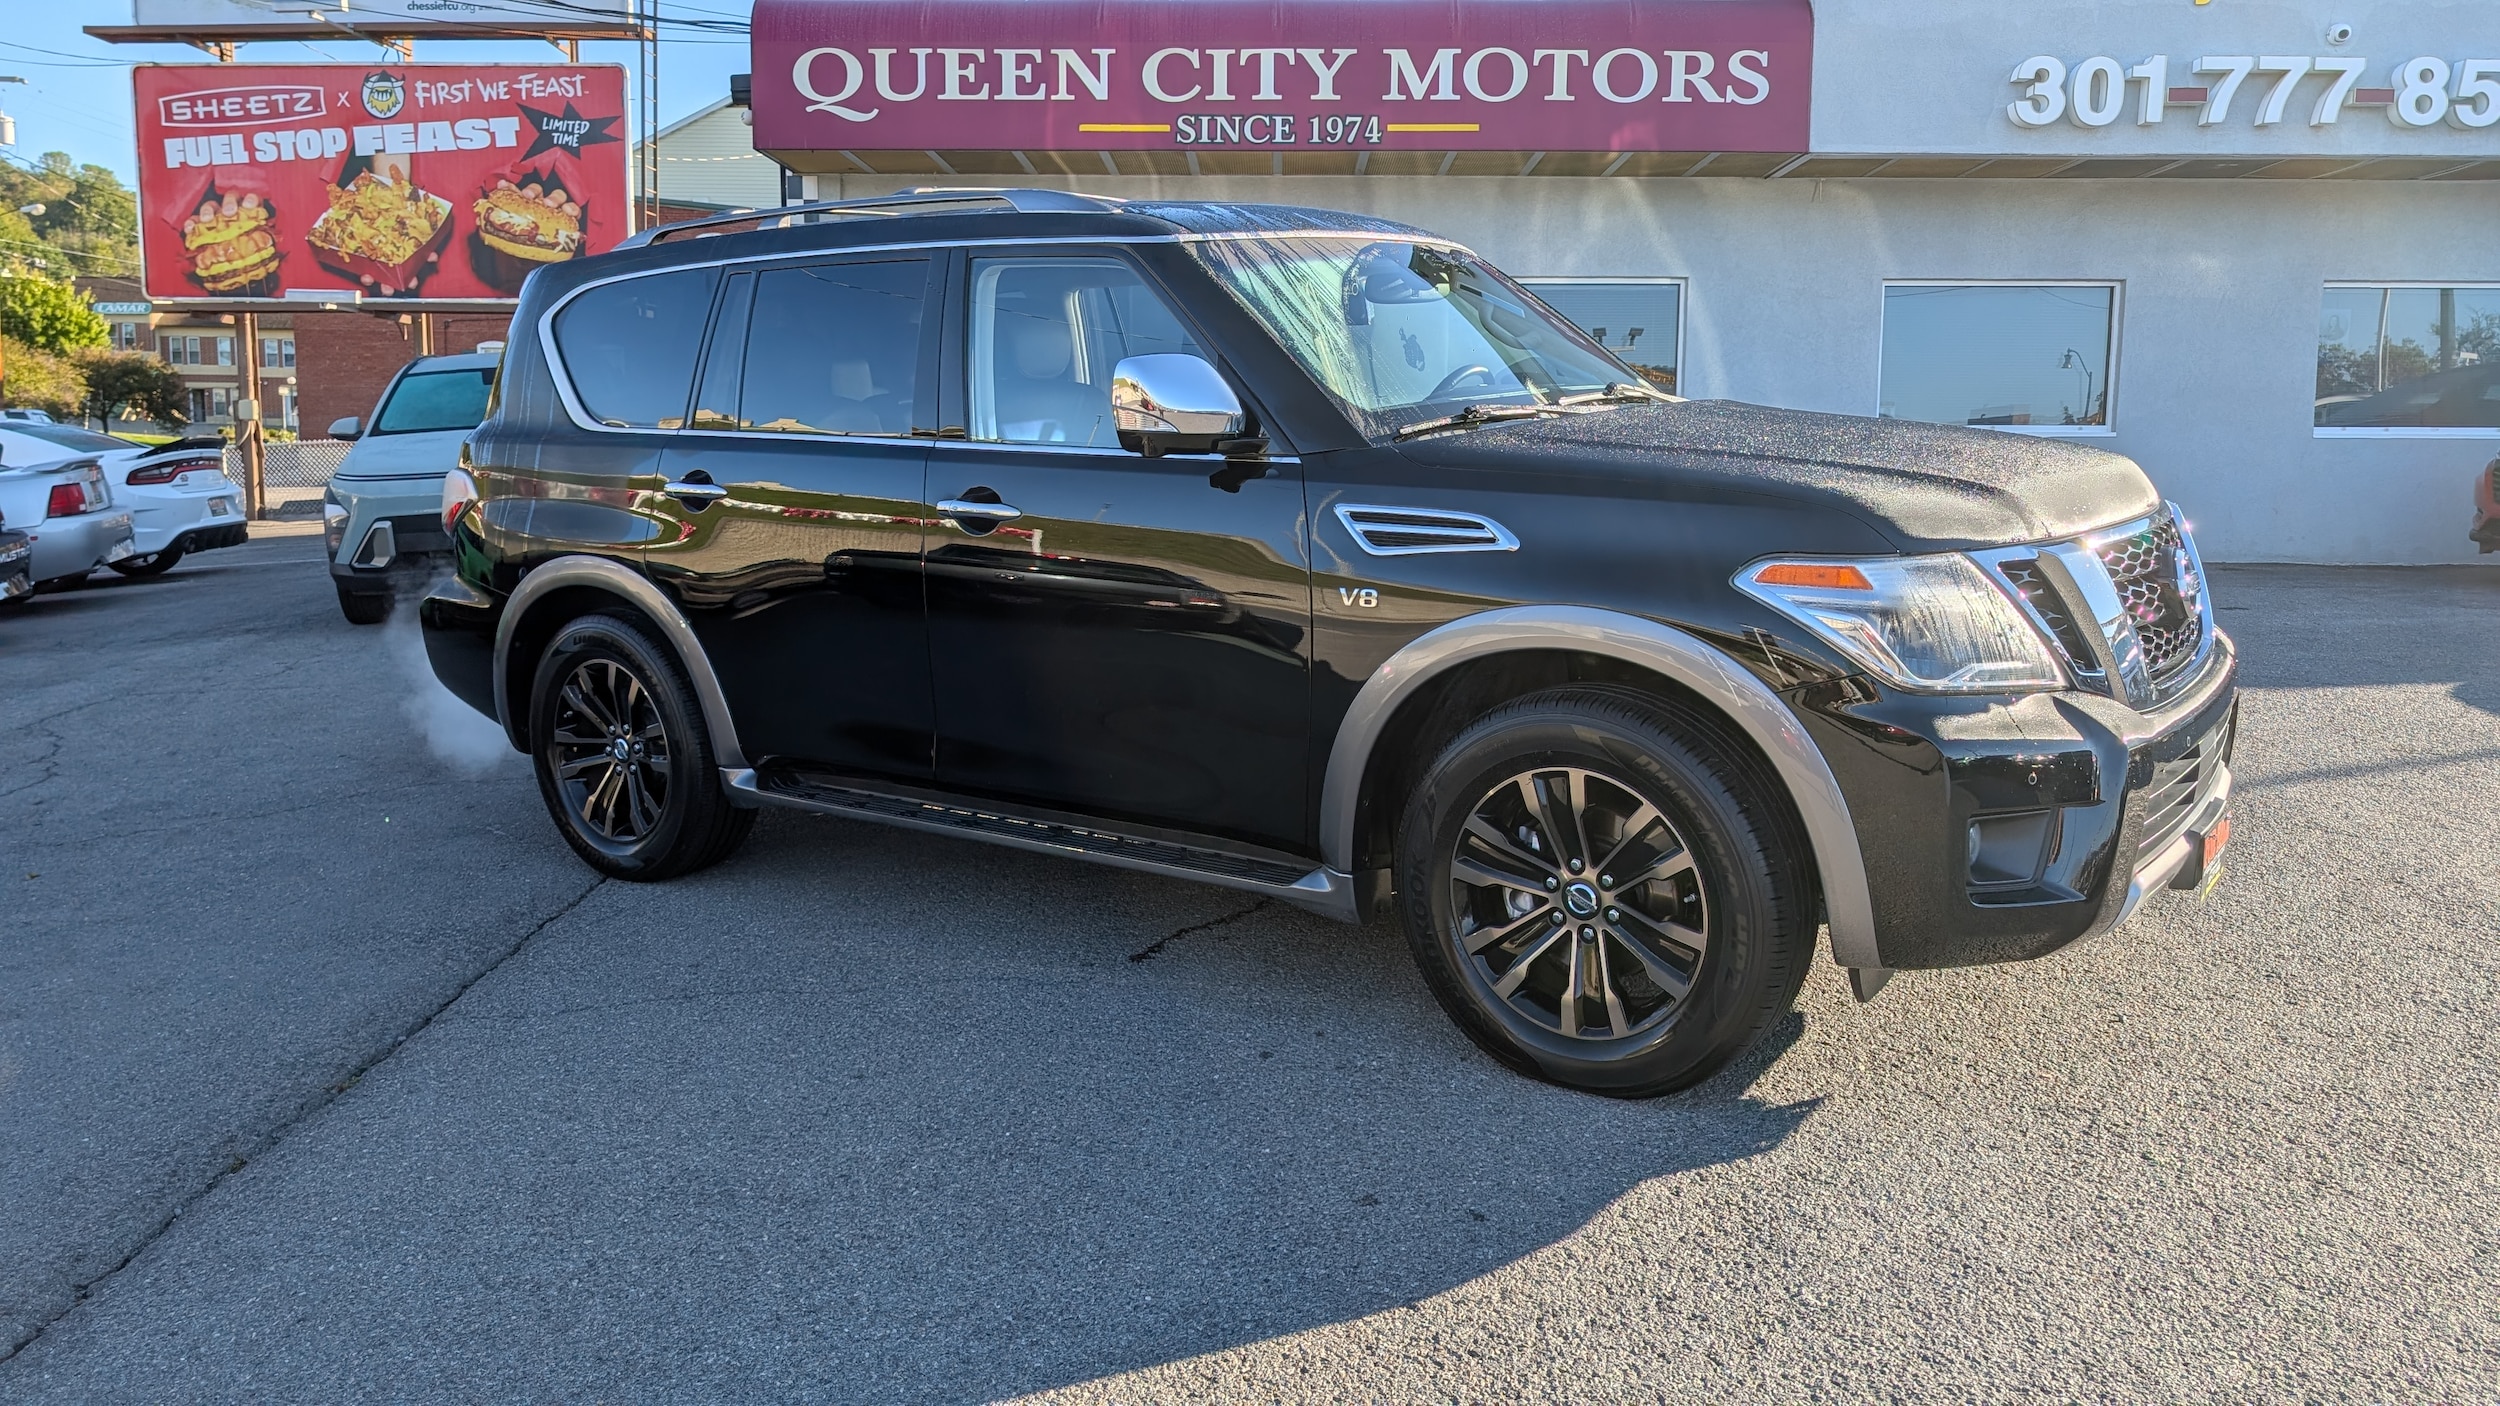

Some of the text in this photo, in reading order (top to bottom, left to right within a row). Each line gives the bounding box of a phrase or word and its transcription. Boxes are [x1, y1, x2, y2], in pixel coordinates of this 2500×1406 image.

[171, 93, 314, 121] SHEETZ
[414, 78, 474, 109] FIRST
[476, 78, 511, 103] WE
[512, 73, 586, 100] FEAST
[791, 46, 1770, 123] QUEEN CITY MOTORS
[542, 117, 590, 134] LIMITED
[1175, 114, 1383, 145] SINCE 1974
[164, 117, 521, 169] FUEL STOP FEAST
[551, 131, 580, 147] TIME
[97, 302, 147, 313] LAMAR
[1339, 587, 1379, 609] V8
